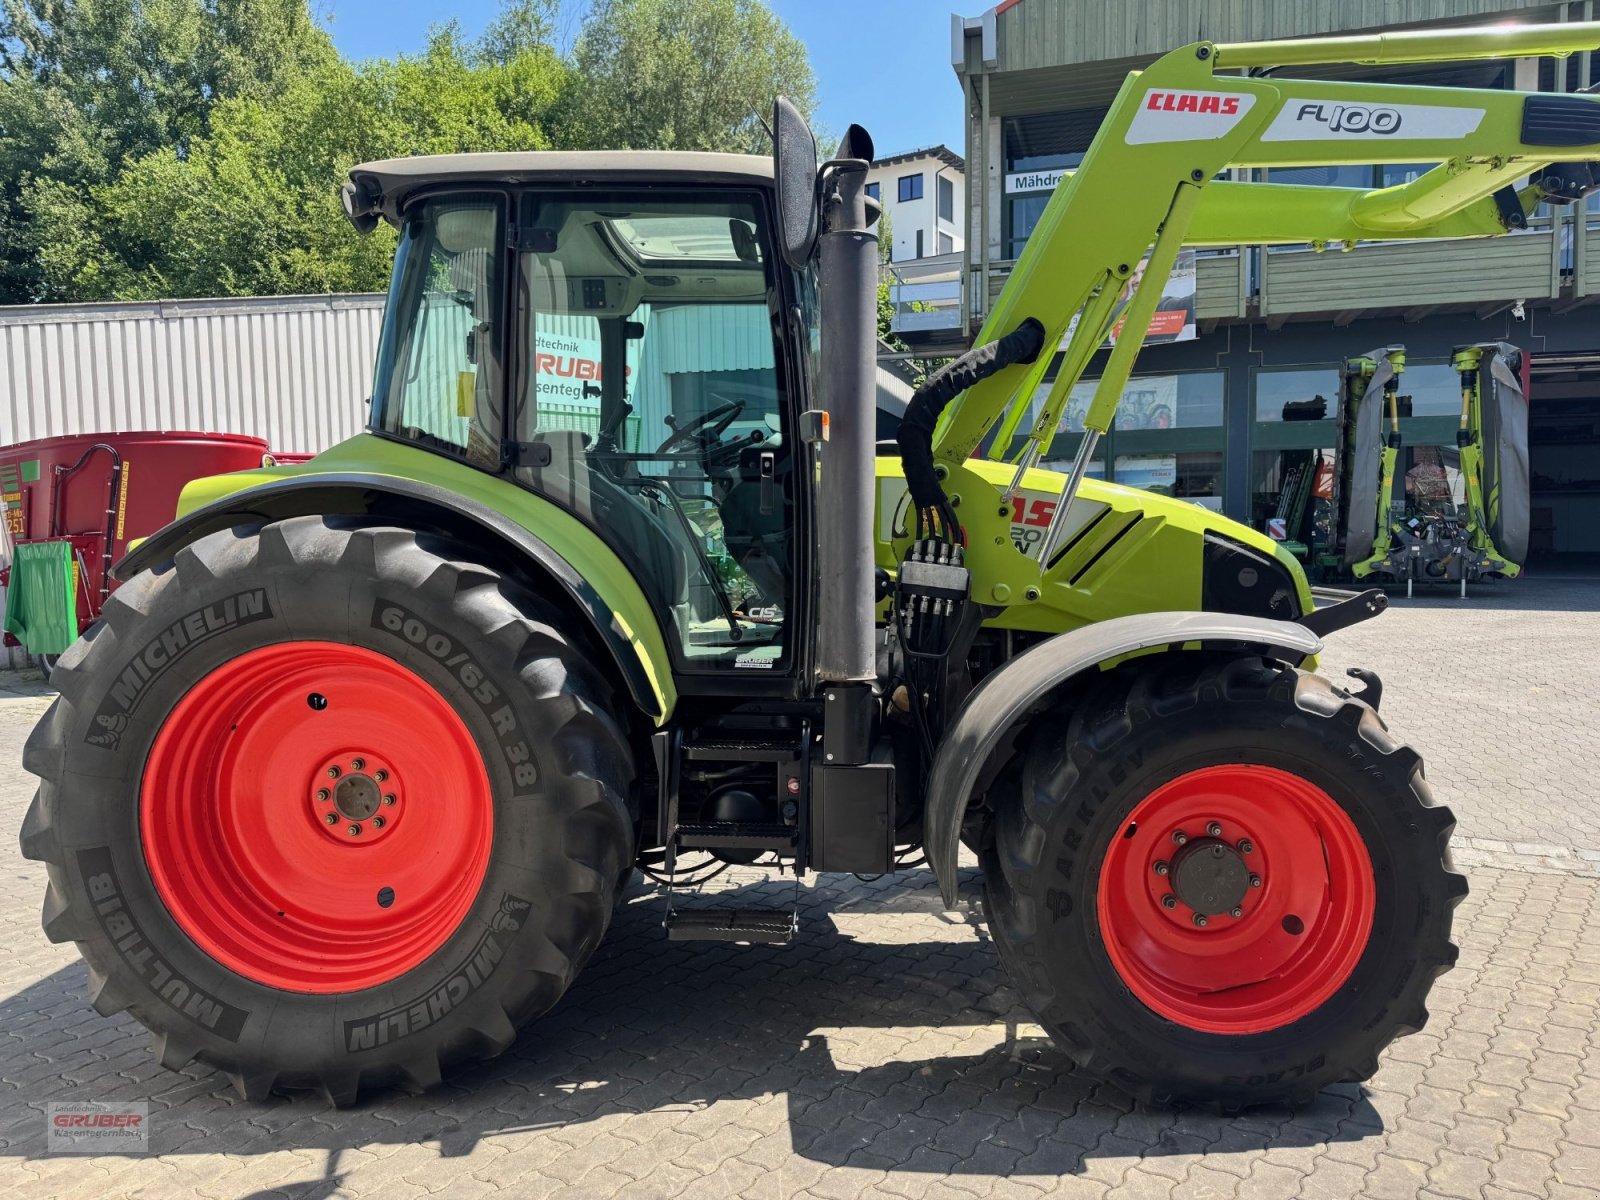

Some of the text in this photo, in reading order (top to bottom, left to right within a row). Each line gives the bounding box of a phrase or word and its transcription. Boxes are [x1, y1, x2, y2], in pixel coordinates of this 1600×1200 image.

[1147, 93, 1241, 115] CLAAS
[91, 590, 264, 709] MICHELIN
[748, 607, 777, 618] CIS
[381, 607, 538, 787] 600/65 R 38
[88, 872, 224, 1028] MULTIBIB
[349, 935, 505, 1051] MICHELIN
